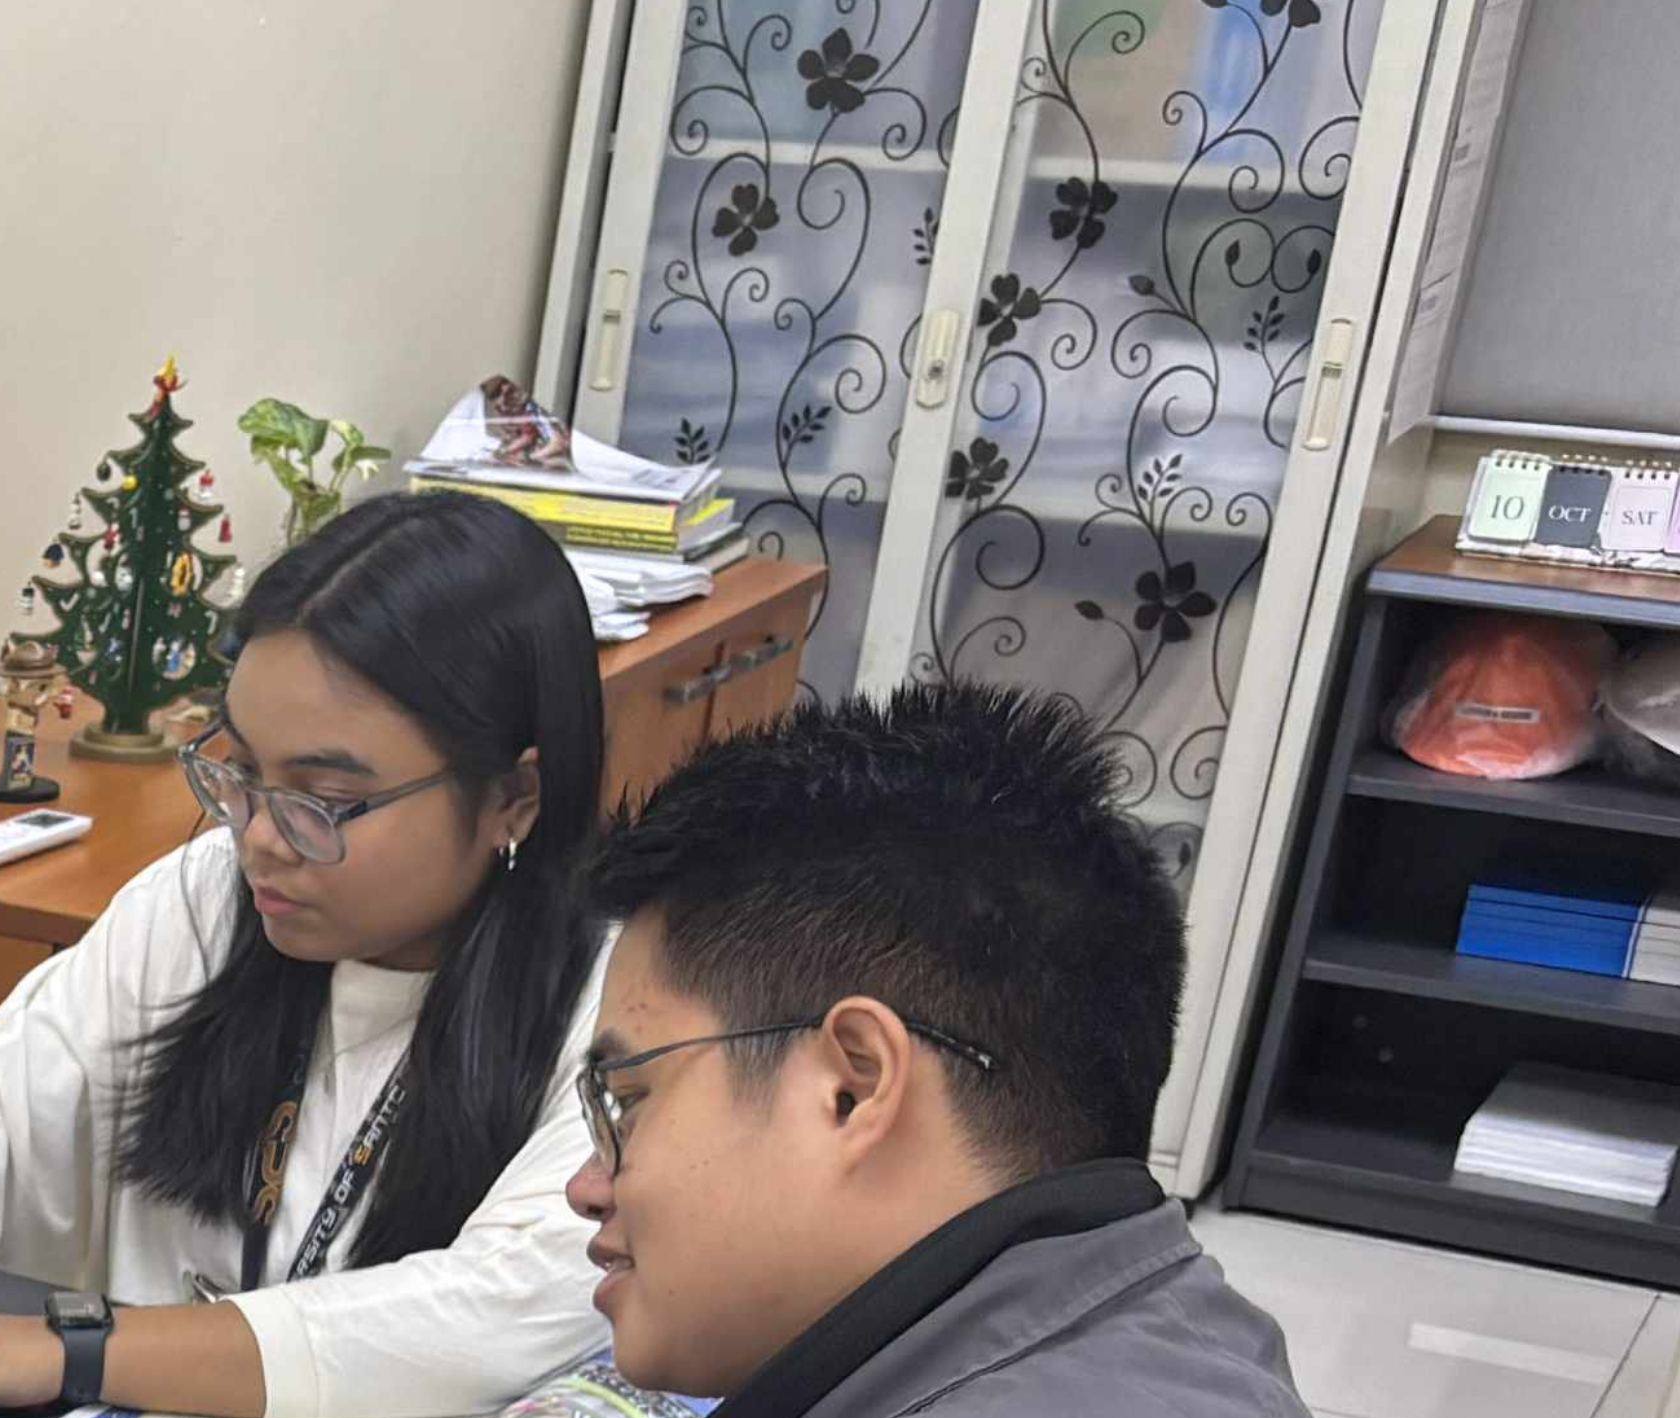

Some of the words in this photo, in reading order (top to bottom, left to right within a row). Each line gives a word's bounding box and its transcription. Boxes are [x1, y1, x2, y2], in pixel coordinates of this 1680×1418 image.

[1490, 495, 1524, 520] 10
[1548, 504, 1591, 522] OCT
[1621, 510, 1658, 526] SAT
